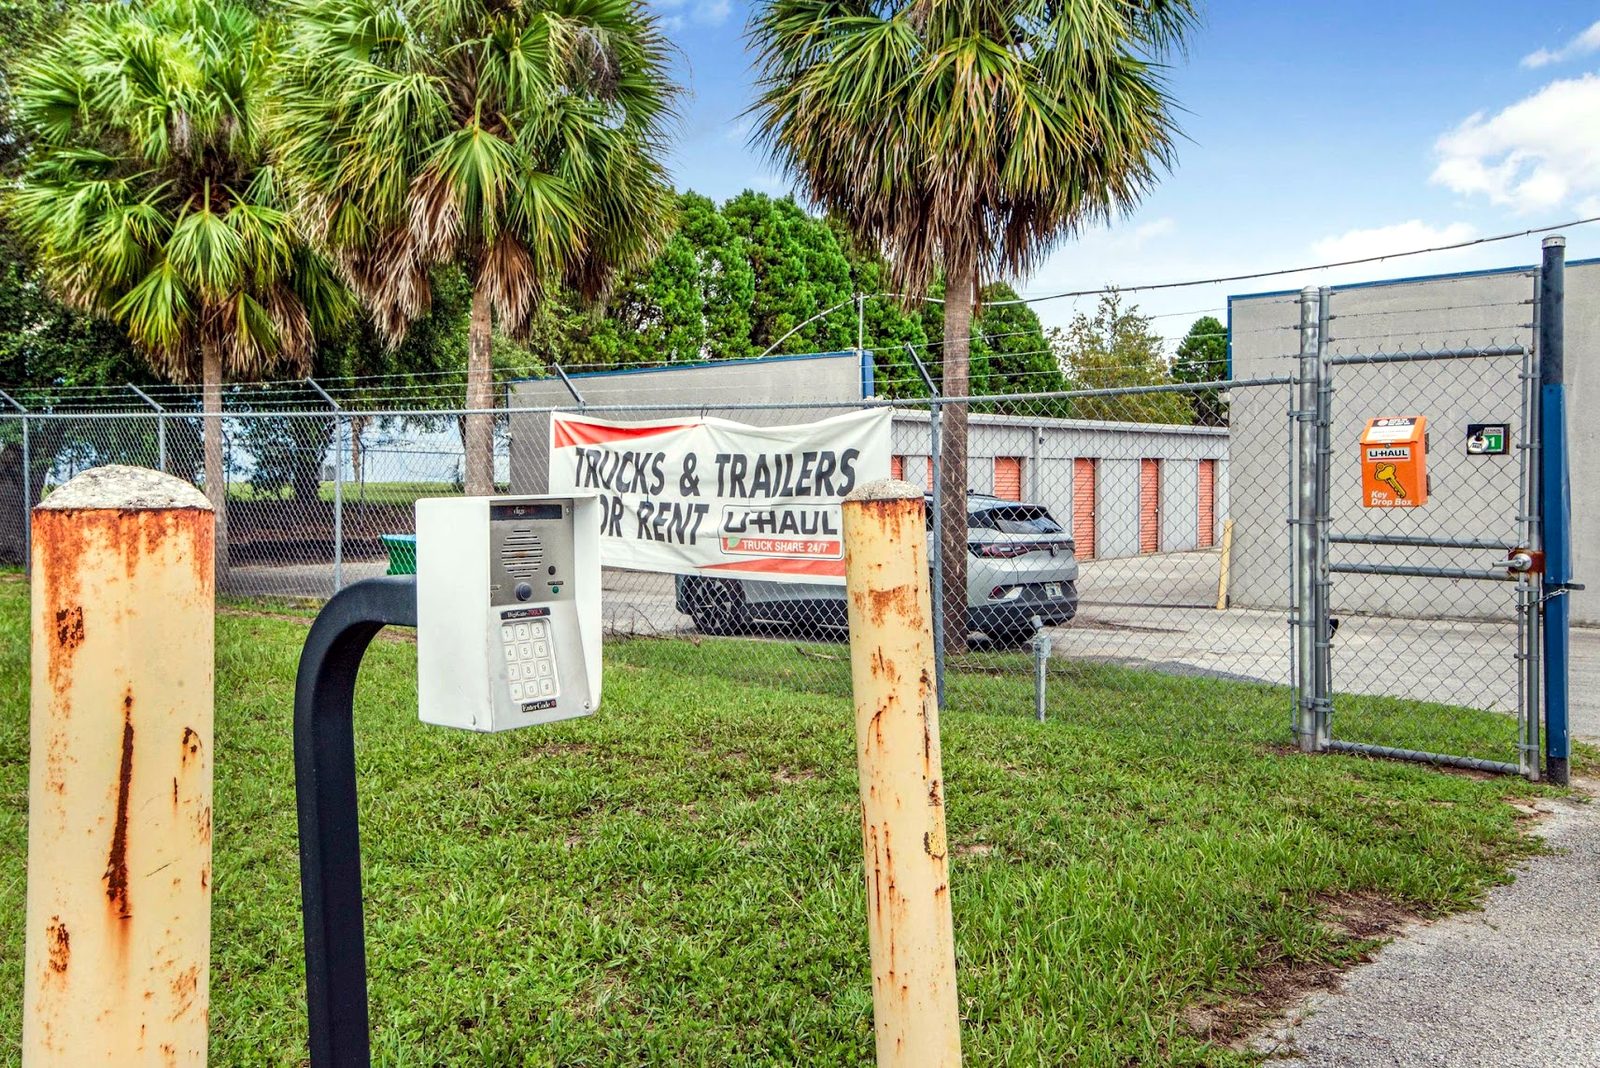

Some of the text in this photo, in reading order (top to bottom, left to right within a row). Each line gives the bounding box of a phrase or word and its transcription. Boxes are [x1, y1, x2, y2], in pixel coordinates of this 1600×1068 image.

[1489, 438, 1496, 448] 1
[575, 447, 860, 498] TRUCKS & TRAILERS
[1371, 490, 1388, 499] Key
[1371, 498, 1412, 506] Drop Box
[636, 501, 710, 545] RENT
[723, 510, 838, 535] U-HAUL
[741, 540, 827, 553] TRUCK SHARE 24/7
